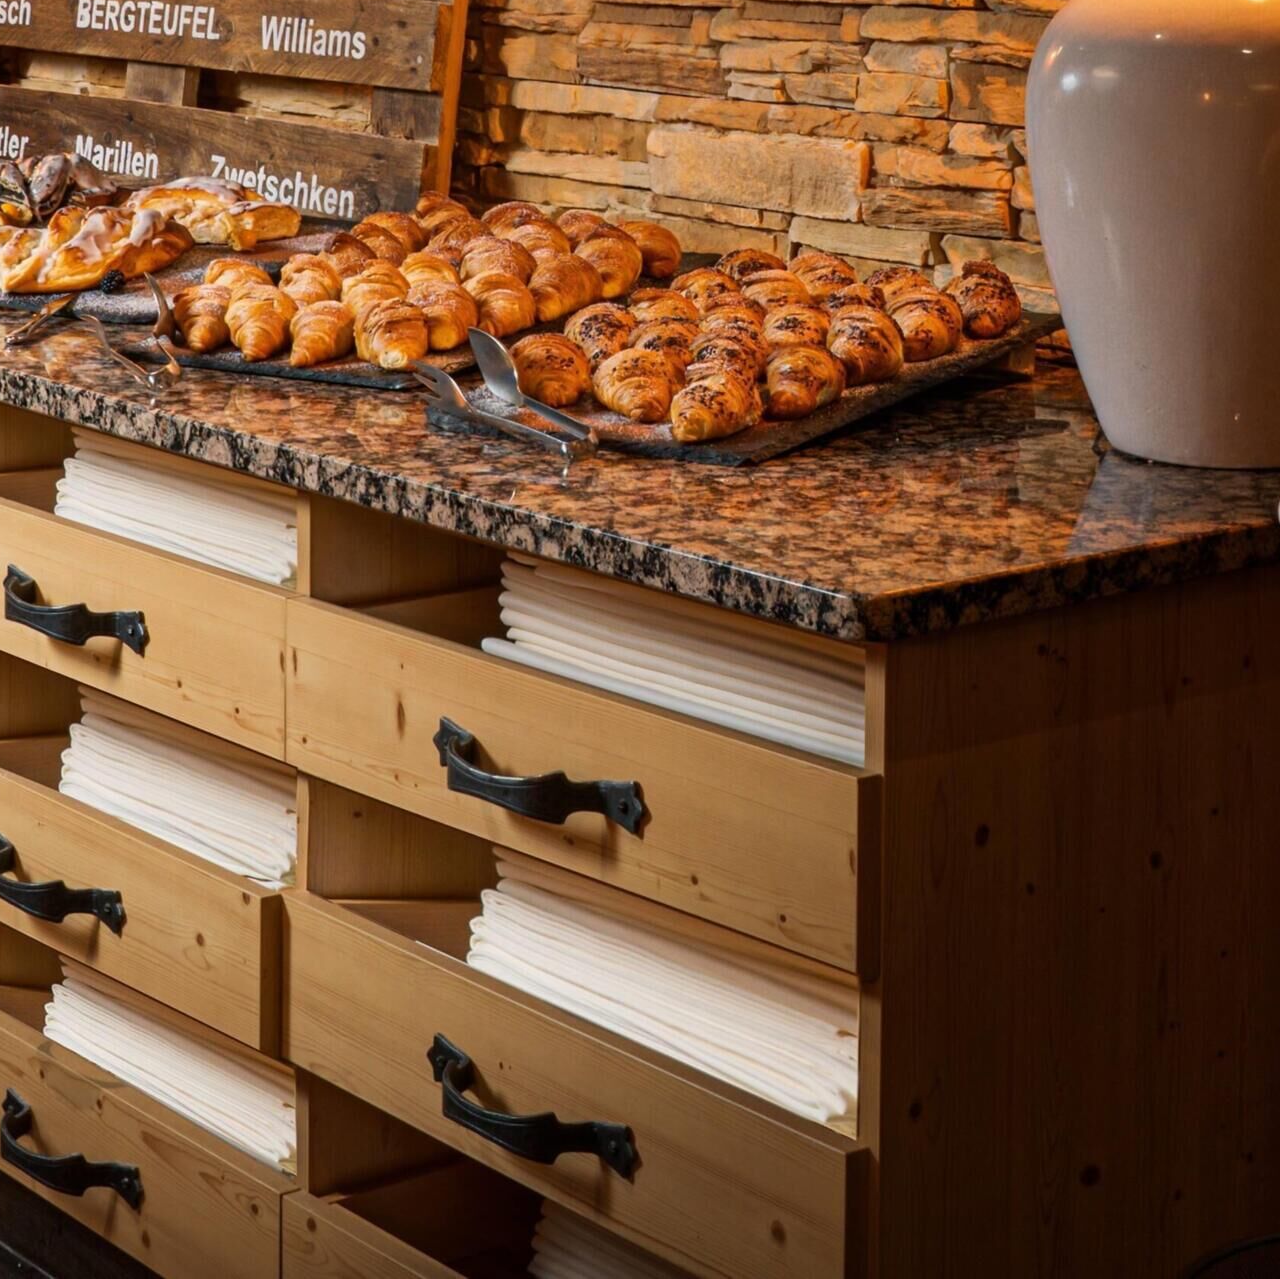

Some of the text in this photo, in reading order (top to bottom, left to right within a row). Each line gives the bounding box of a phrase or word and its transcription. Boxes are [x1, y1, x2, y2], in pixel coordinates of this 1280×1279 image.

[262, 16, 365, 59] Williams
[75, 134, 159, 179] Marillen
[211, 154, 354, 219] Zwetschken
